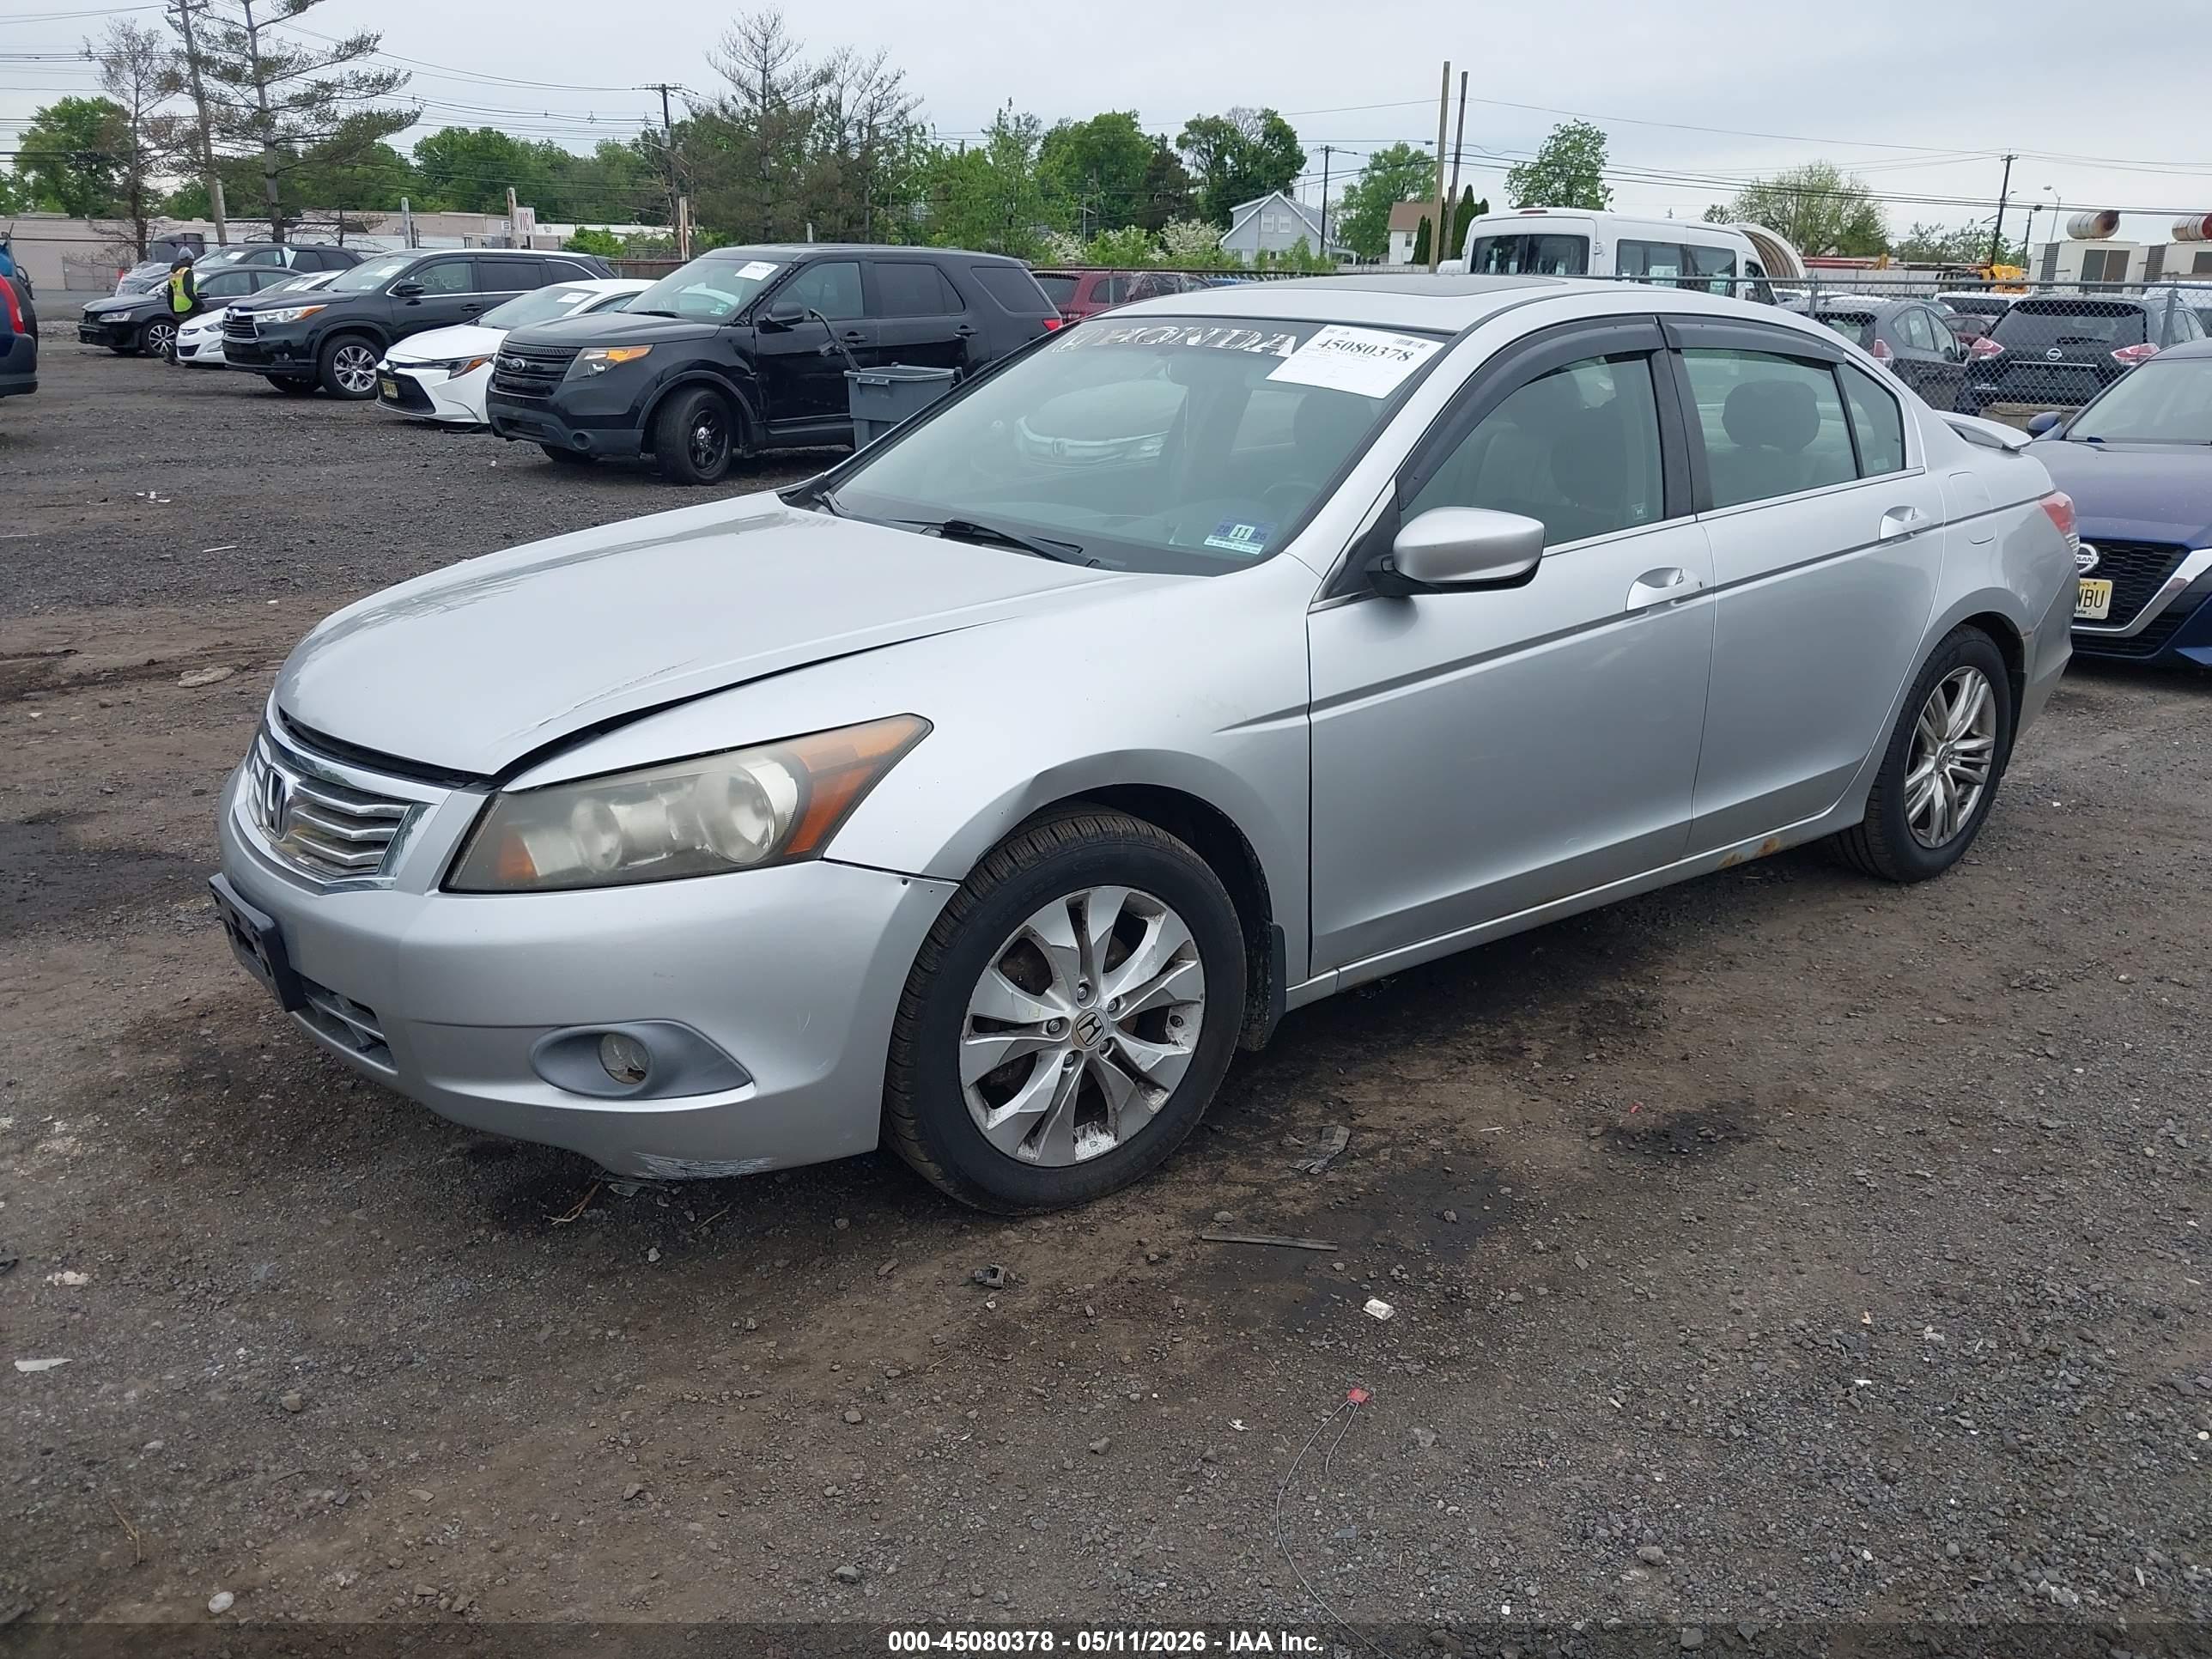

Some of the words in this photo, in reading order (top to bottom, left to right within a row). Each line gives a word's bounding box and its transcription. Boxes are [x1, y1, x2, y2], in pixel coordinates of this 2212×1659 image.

[518, 212, 529, 231] VIC
[1317, 338, 1415, 362] 45080378
[1232, 526, 1250, 538] 11
